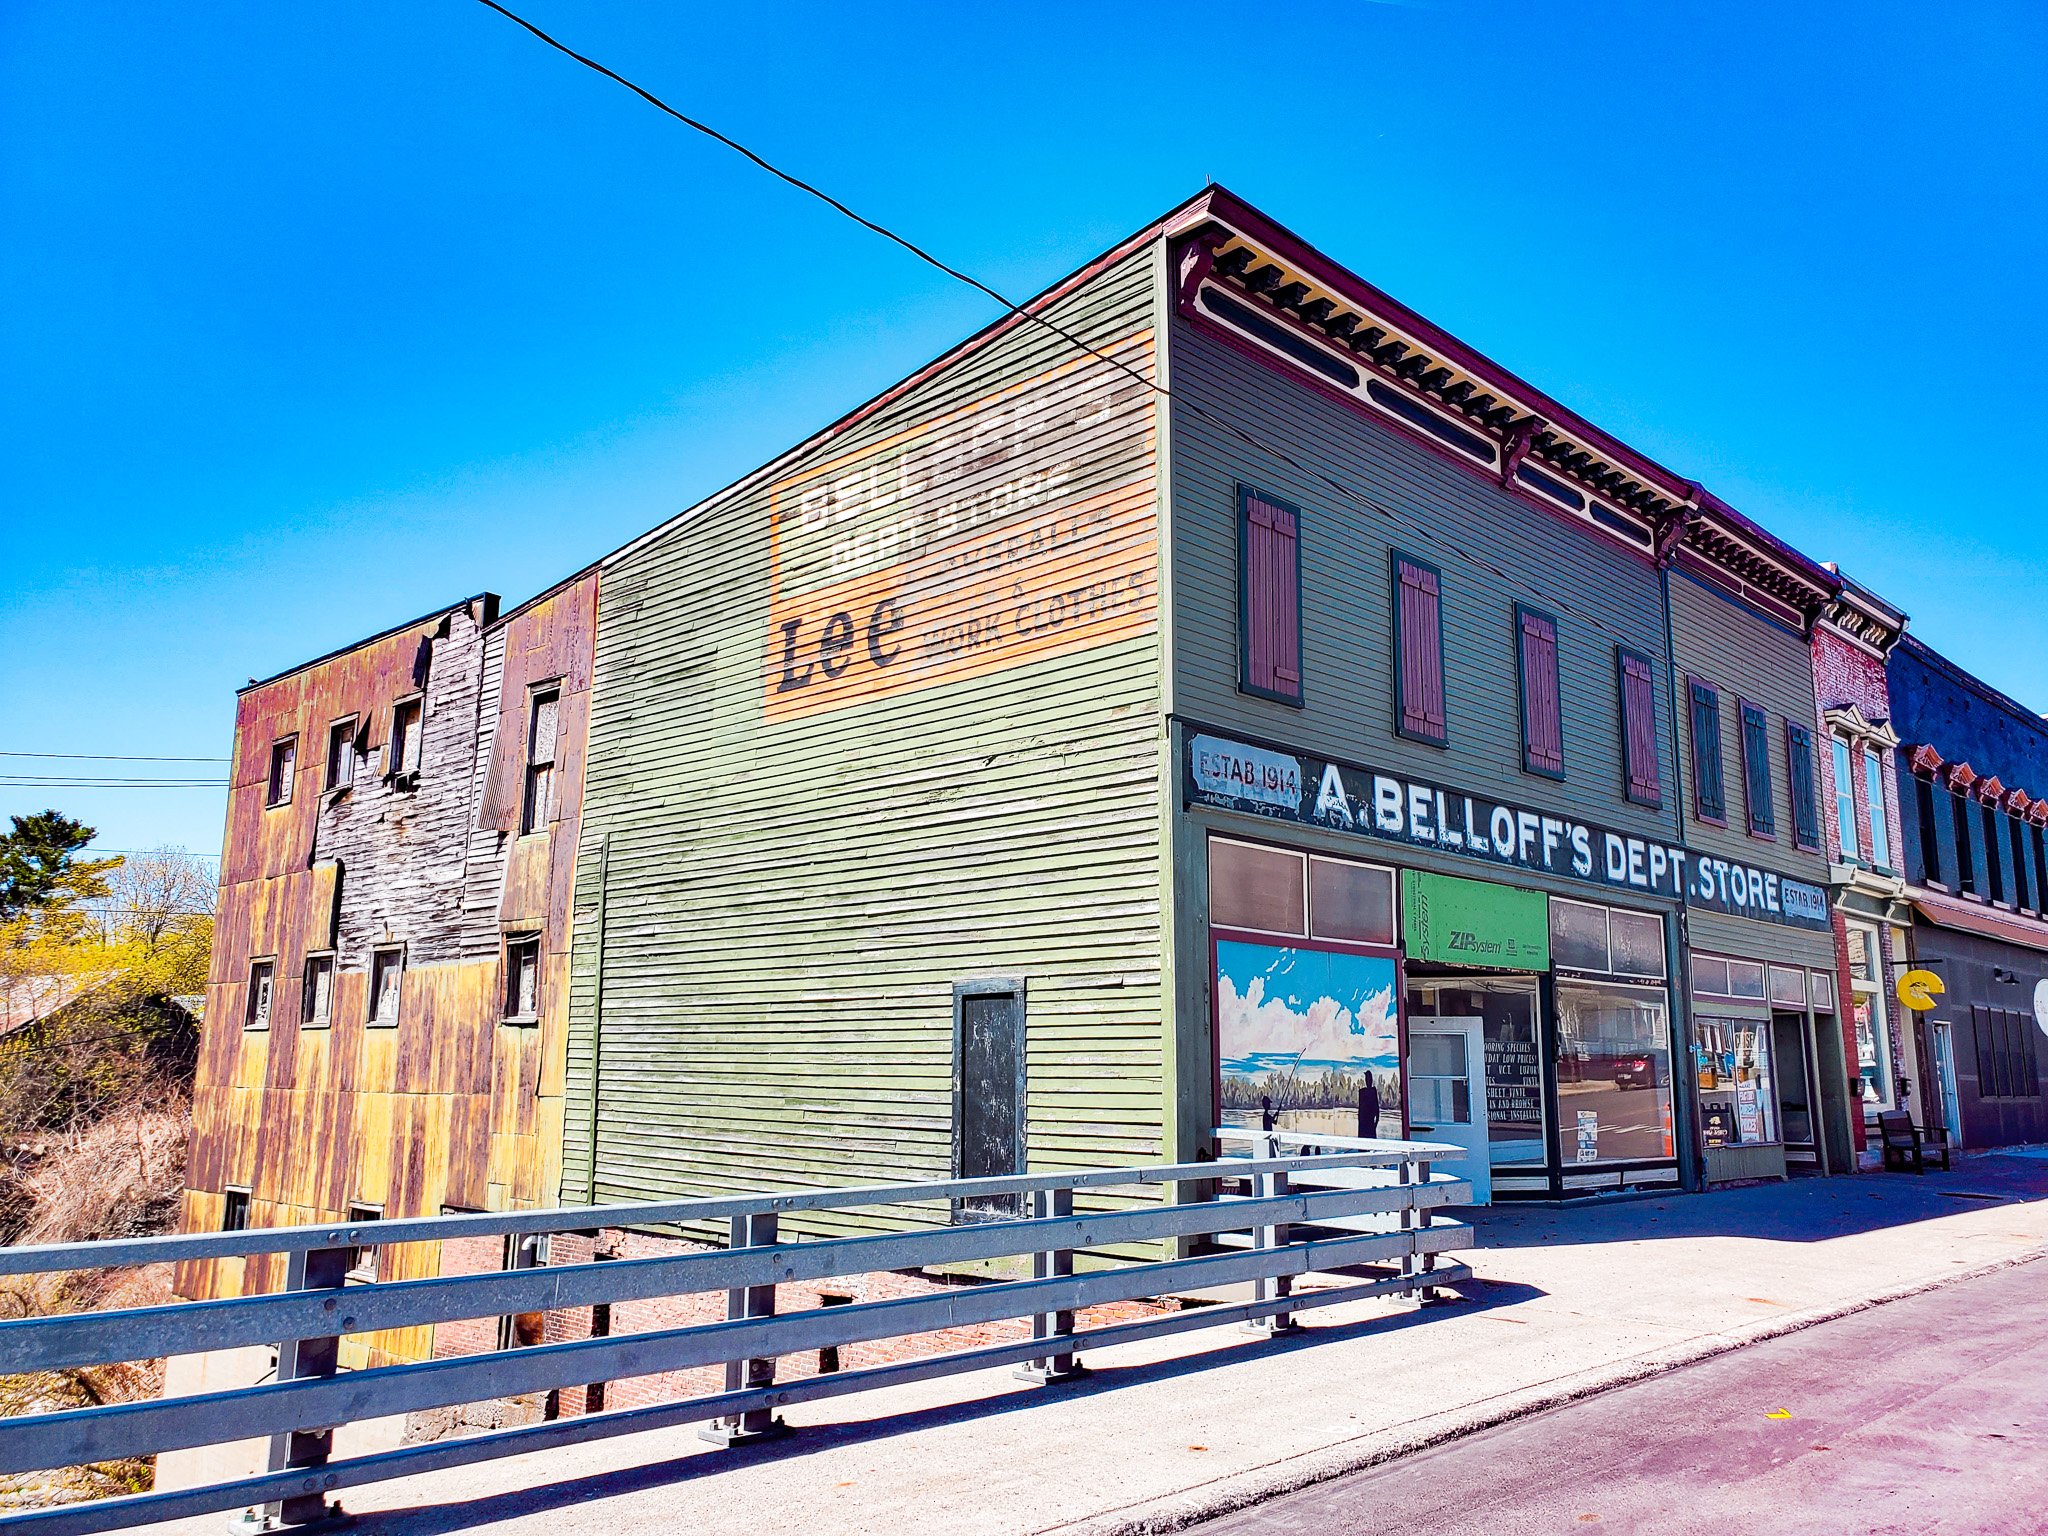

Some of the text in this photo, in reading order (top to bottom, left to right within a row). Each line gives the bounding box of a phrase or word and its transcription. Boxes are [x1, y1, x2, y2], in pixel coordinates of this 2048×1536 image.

[936, 462, 1072, 537] STORE
[776, 597, 905, 694] Lee
[923, 571, 1146, 659] WORK CLOTHES
[1261, 764, 1296, 795] 1914
[1373, 774, 1593, 878] BELLOFF'S
[1698, 857, 1779, 912] STORE
[1487, 1088, 1526, 1098] SHEET VINYL
[1503, 1054, 1516, 1063] LOW
